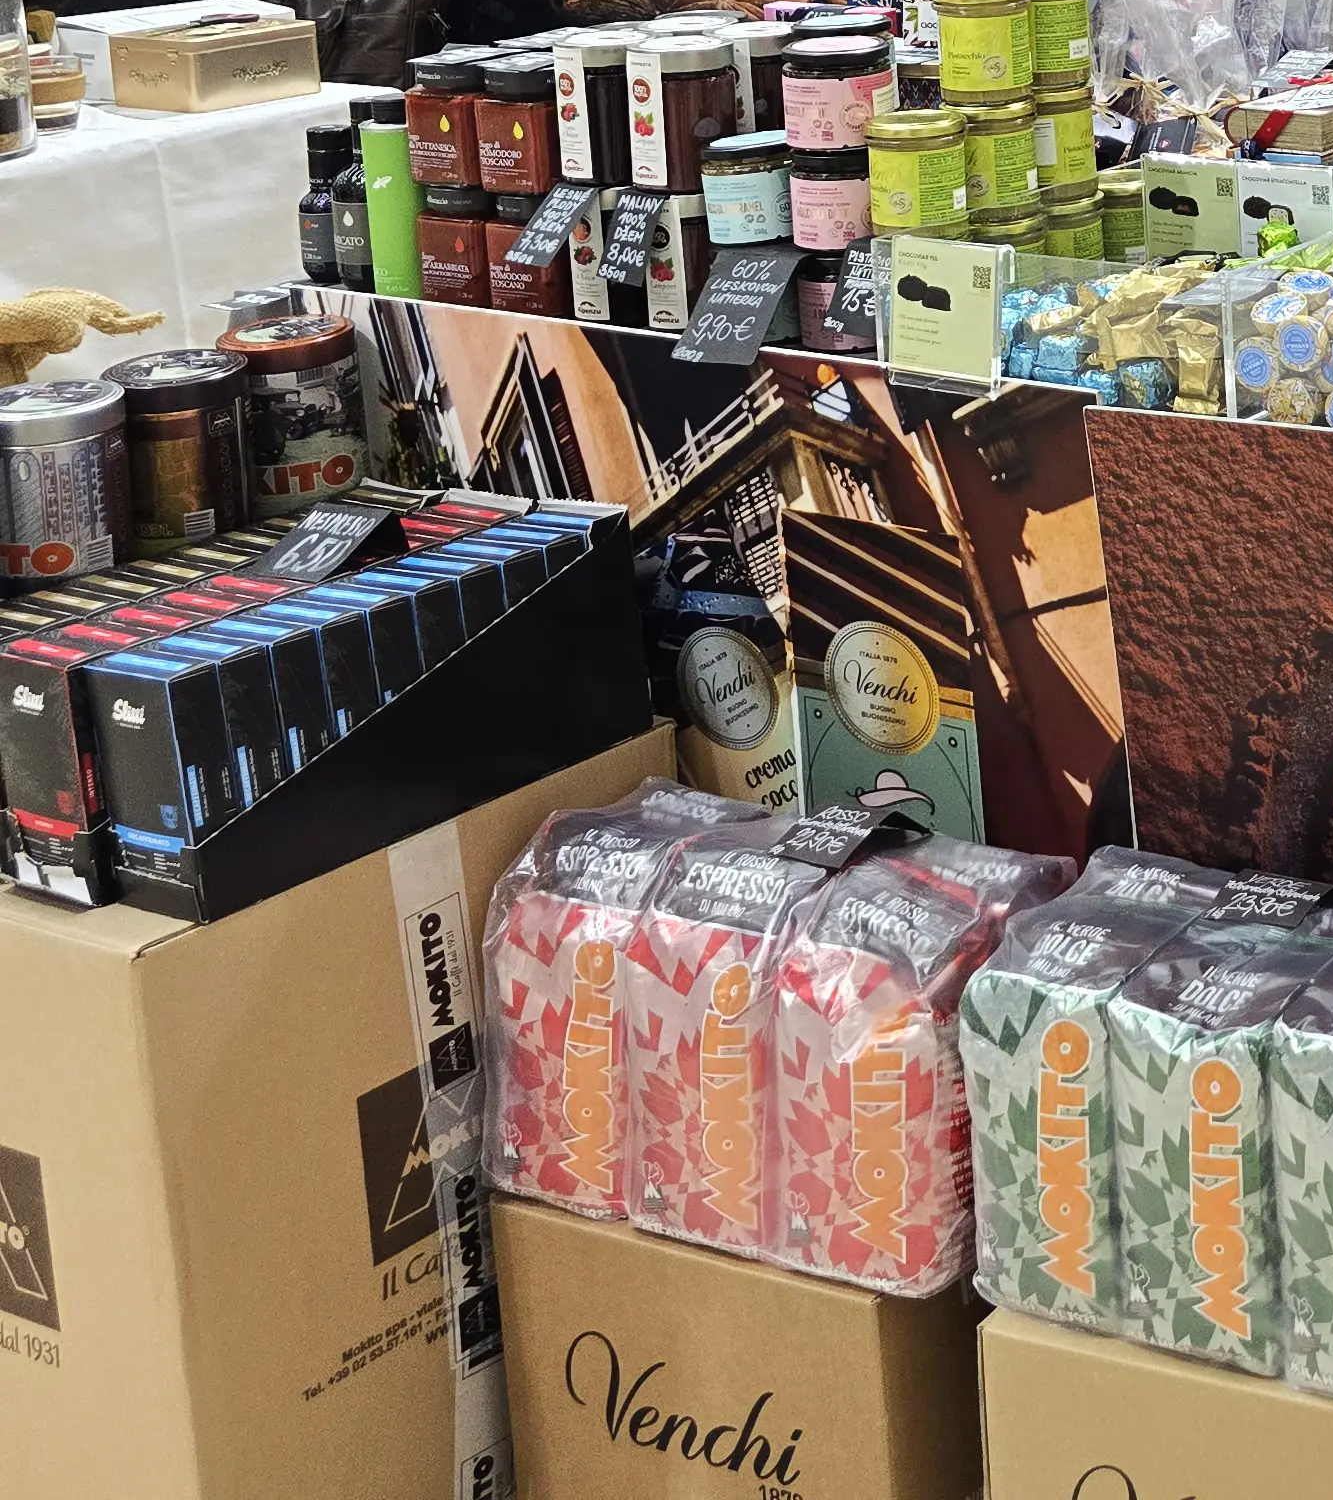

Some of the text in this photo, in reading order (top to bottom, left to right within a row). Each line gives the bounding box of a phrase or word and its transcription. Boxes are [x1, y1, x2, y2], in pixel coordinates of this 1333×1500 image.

[731, 259, 777, 280] 60%
[299, 510, 376, 537] NESPRESSO
[696, 664, 756, 705] Venchi
[844, 660, 918, 705] Venchi
[861, 711, 907, 727] BUONISSIMO
[869, 703, 896, 714] BUONO
[745, 748, 796, 789] crema
[684, 861, 788, 905] ESPRESSO
[419, 912, 455, 1026] MOKITO
[1031, 933, 1102, 966] DOLCE
[1178, 979, 1255, 1012] DOLCE
[558, 939, 618, 1193] MOKITO
[702, 961, 758, 1230] MOKITO
[1038, 1018, 1096, 1298] MOKITO
[1189, 1057, 1252, 1340] MOKITO
[23, 1333, 61, 1369] 1931
[328, 1367, 351, 1385] +39
[352, 1356, 368, 1372] 02
[565, 1330, 803, 1486] Venchi
